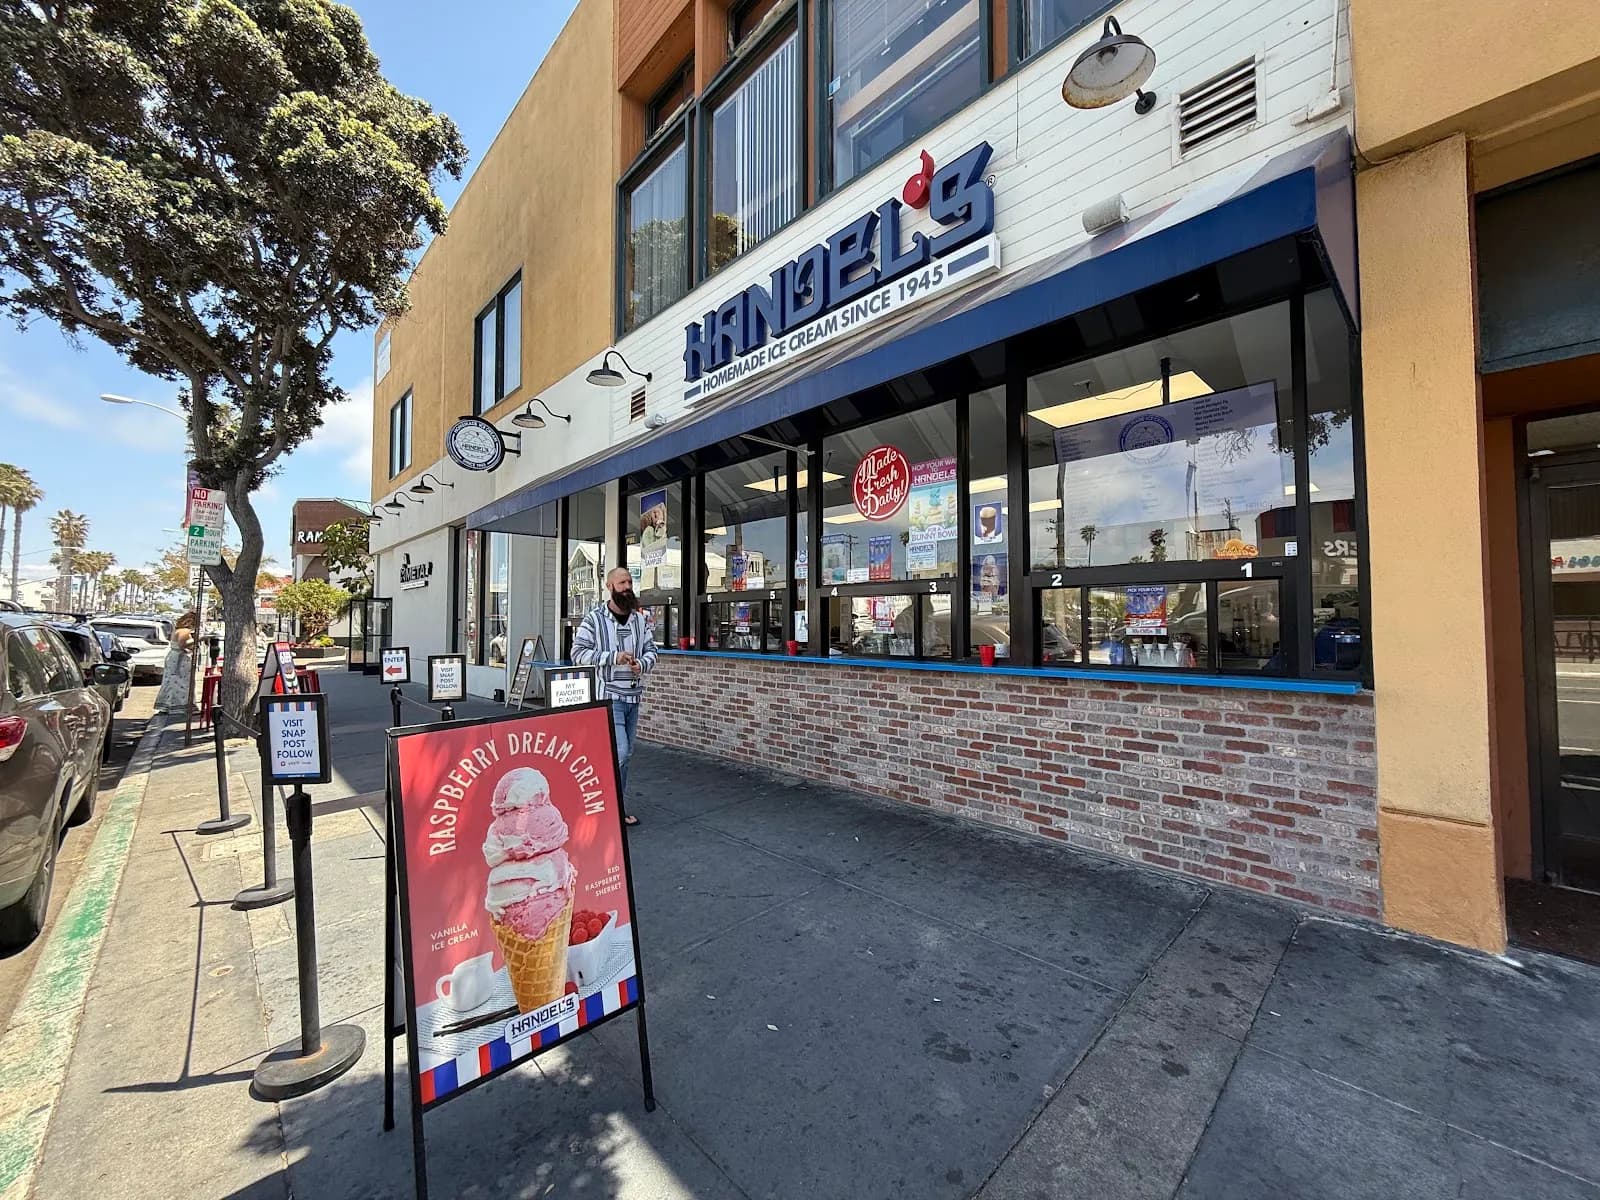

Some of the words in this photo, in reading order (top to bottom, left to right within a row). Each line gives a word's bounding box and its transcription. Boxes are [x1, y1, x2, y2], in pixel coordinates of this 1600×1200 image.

[684, 140, 994, 382] HANDEL'S
[703, 350, 766, 394] HOMEMADE
[767, 338, 786, 363] ICE
[789, 315, 838, 352] CREAM
[841, 288, 891, 328] SINCE
[898, 264, 944, 300] 1945
[858, 447, 898, 483] Made
[926, 460, 943, 470] YOUR
[944, 457, 957, 467] WA
[862, 465, 899, 500] Fresh
[194, 489, 207, 499] NO
[861, 480, 905, 516] Daily!
[194, 501, 223, 510] PARKING
[194, 527, 200, 536] 2
[912, 532, 936, 541] BUNNY
[191, 540, 219, 549] PARKING
[1241, 562, 1253, 578] 1
[1051, 574, 1063, 587] 2
[831, 587, 837, 597] 4
[929, 582, 937, 592] 3
[770, 591, 775, 600] 5
[556, 689, 585, 697] FAVORITE
[282, 719, 304, 728] VISIT
[281, 729, 306, 738] SNAP
[283, 740, 306, 748] POST
[277, 750, 313, 759] FOLLOW
[428, 739, 501, 857] RASPBERRY
[508, 732, 574, 764] DREAM
[568, 754, 605, 816] CREAM
[607, 865, 620, 874] RED
[585, 874, 621, 891] RASPBERRY
[595, 883, 621, 897] SHERBET
[430, 923, 468, 941] VANILLA
[431, 941, 446, 952] ICE
[447, 929, 479, 946] CREAM
[510, 997, 575, 1036] HANDEL'S
